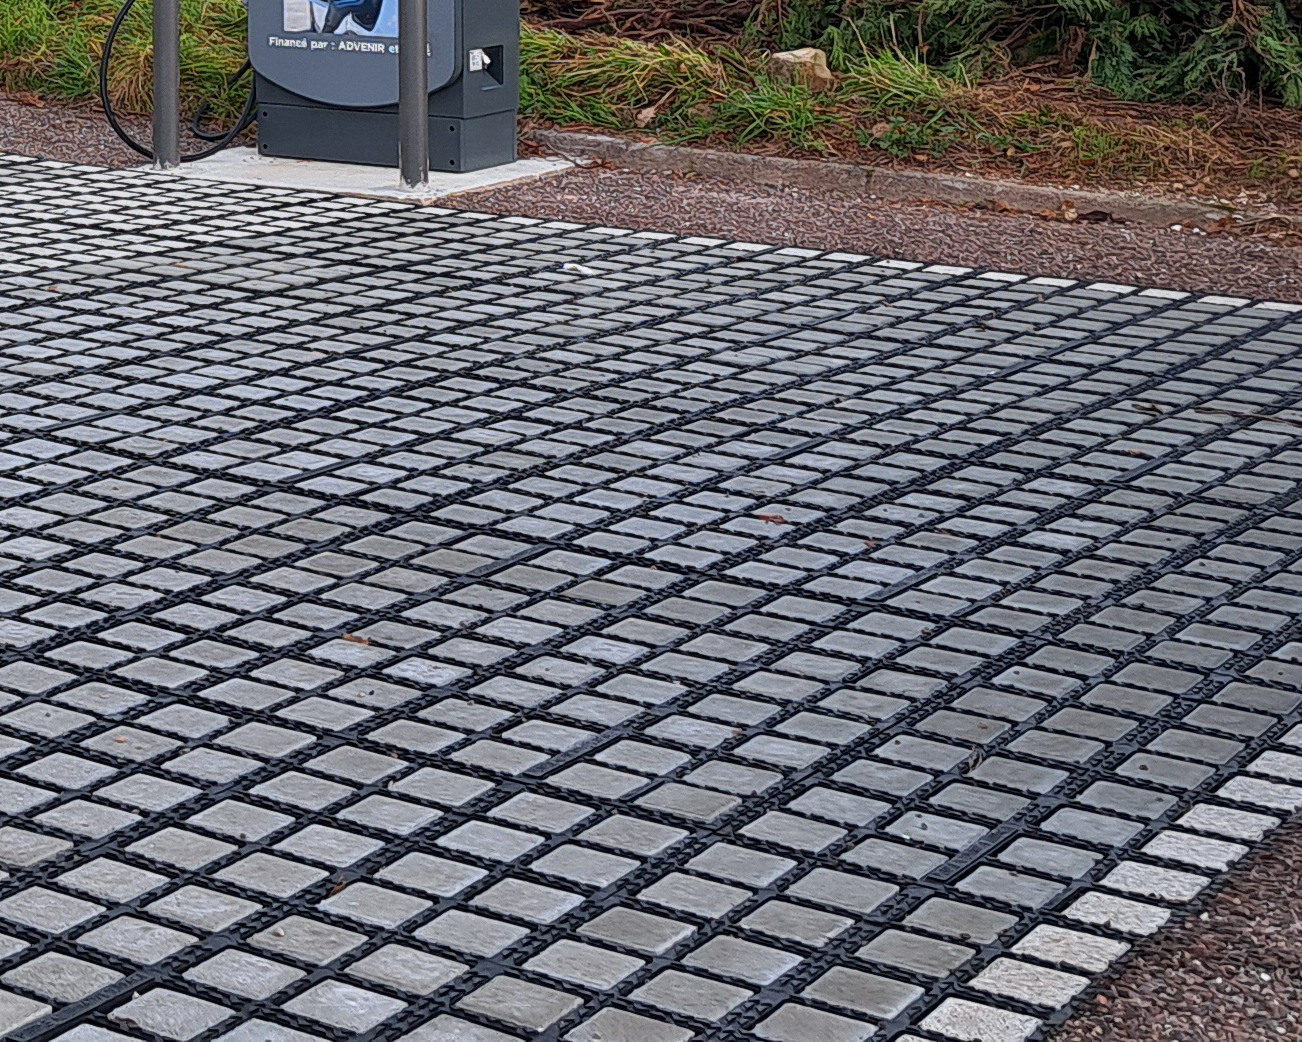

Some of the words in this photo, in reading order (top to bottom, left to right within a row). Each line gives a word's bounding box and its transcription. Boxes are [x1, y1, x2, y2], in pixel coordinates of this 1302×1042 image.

[268, 36, 308, 48] Financé
[310, 40, 329, 51] par
[338, 39, 385, 54] ADVENIR
